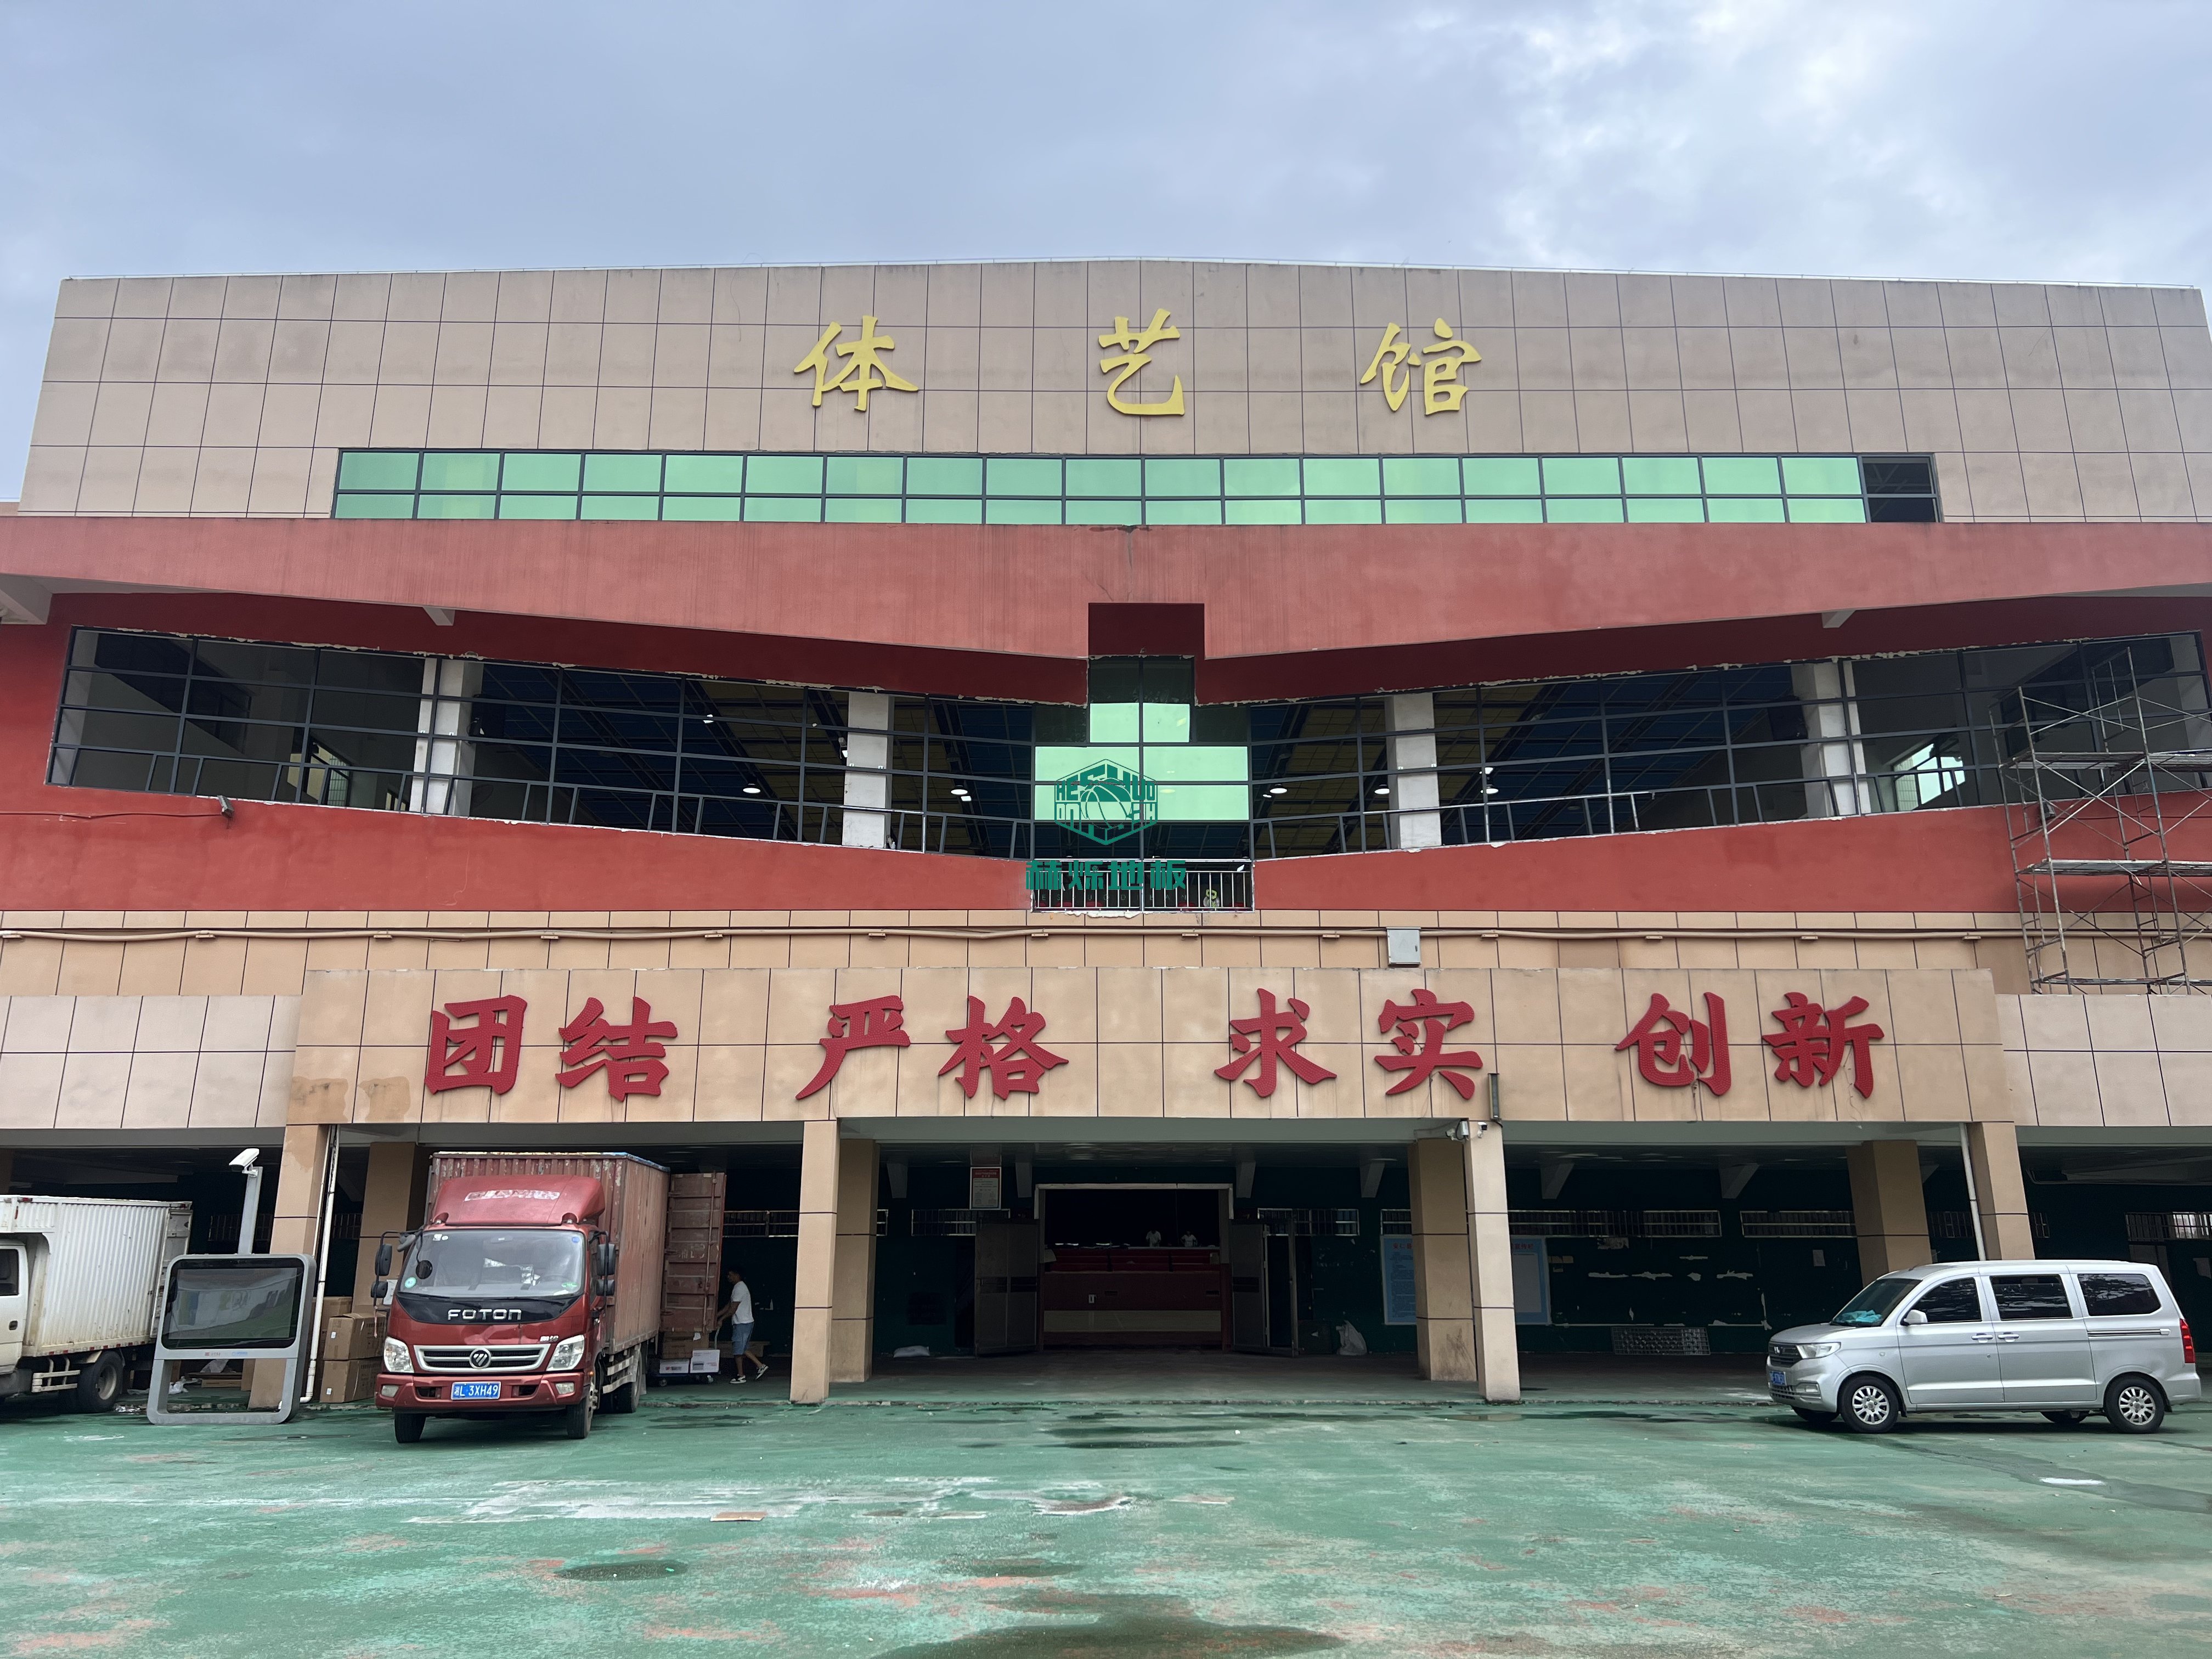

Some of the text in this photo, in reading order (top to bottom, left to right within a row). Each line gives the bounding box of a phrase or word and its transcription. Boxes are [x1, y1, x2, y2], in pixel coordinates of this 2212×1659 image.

[794, 309, 1481, 415] 体艺馆
[425, 988, 1885, 1102] 团结 严格 求实 创新
[448, 1309, 522, 1321] FOTON
